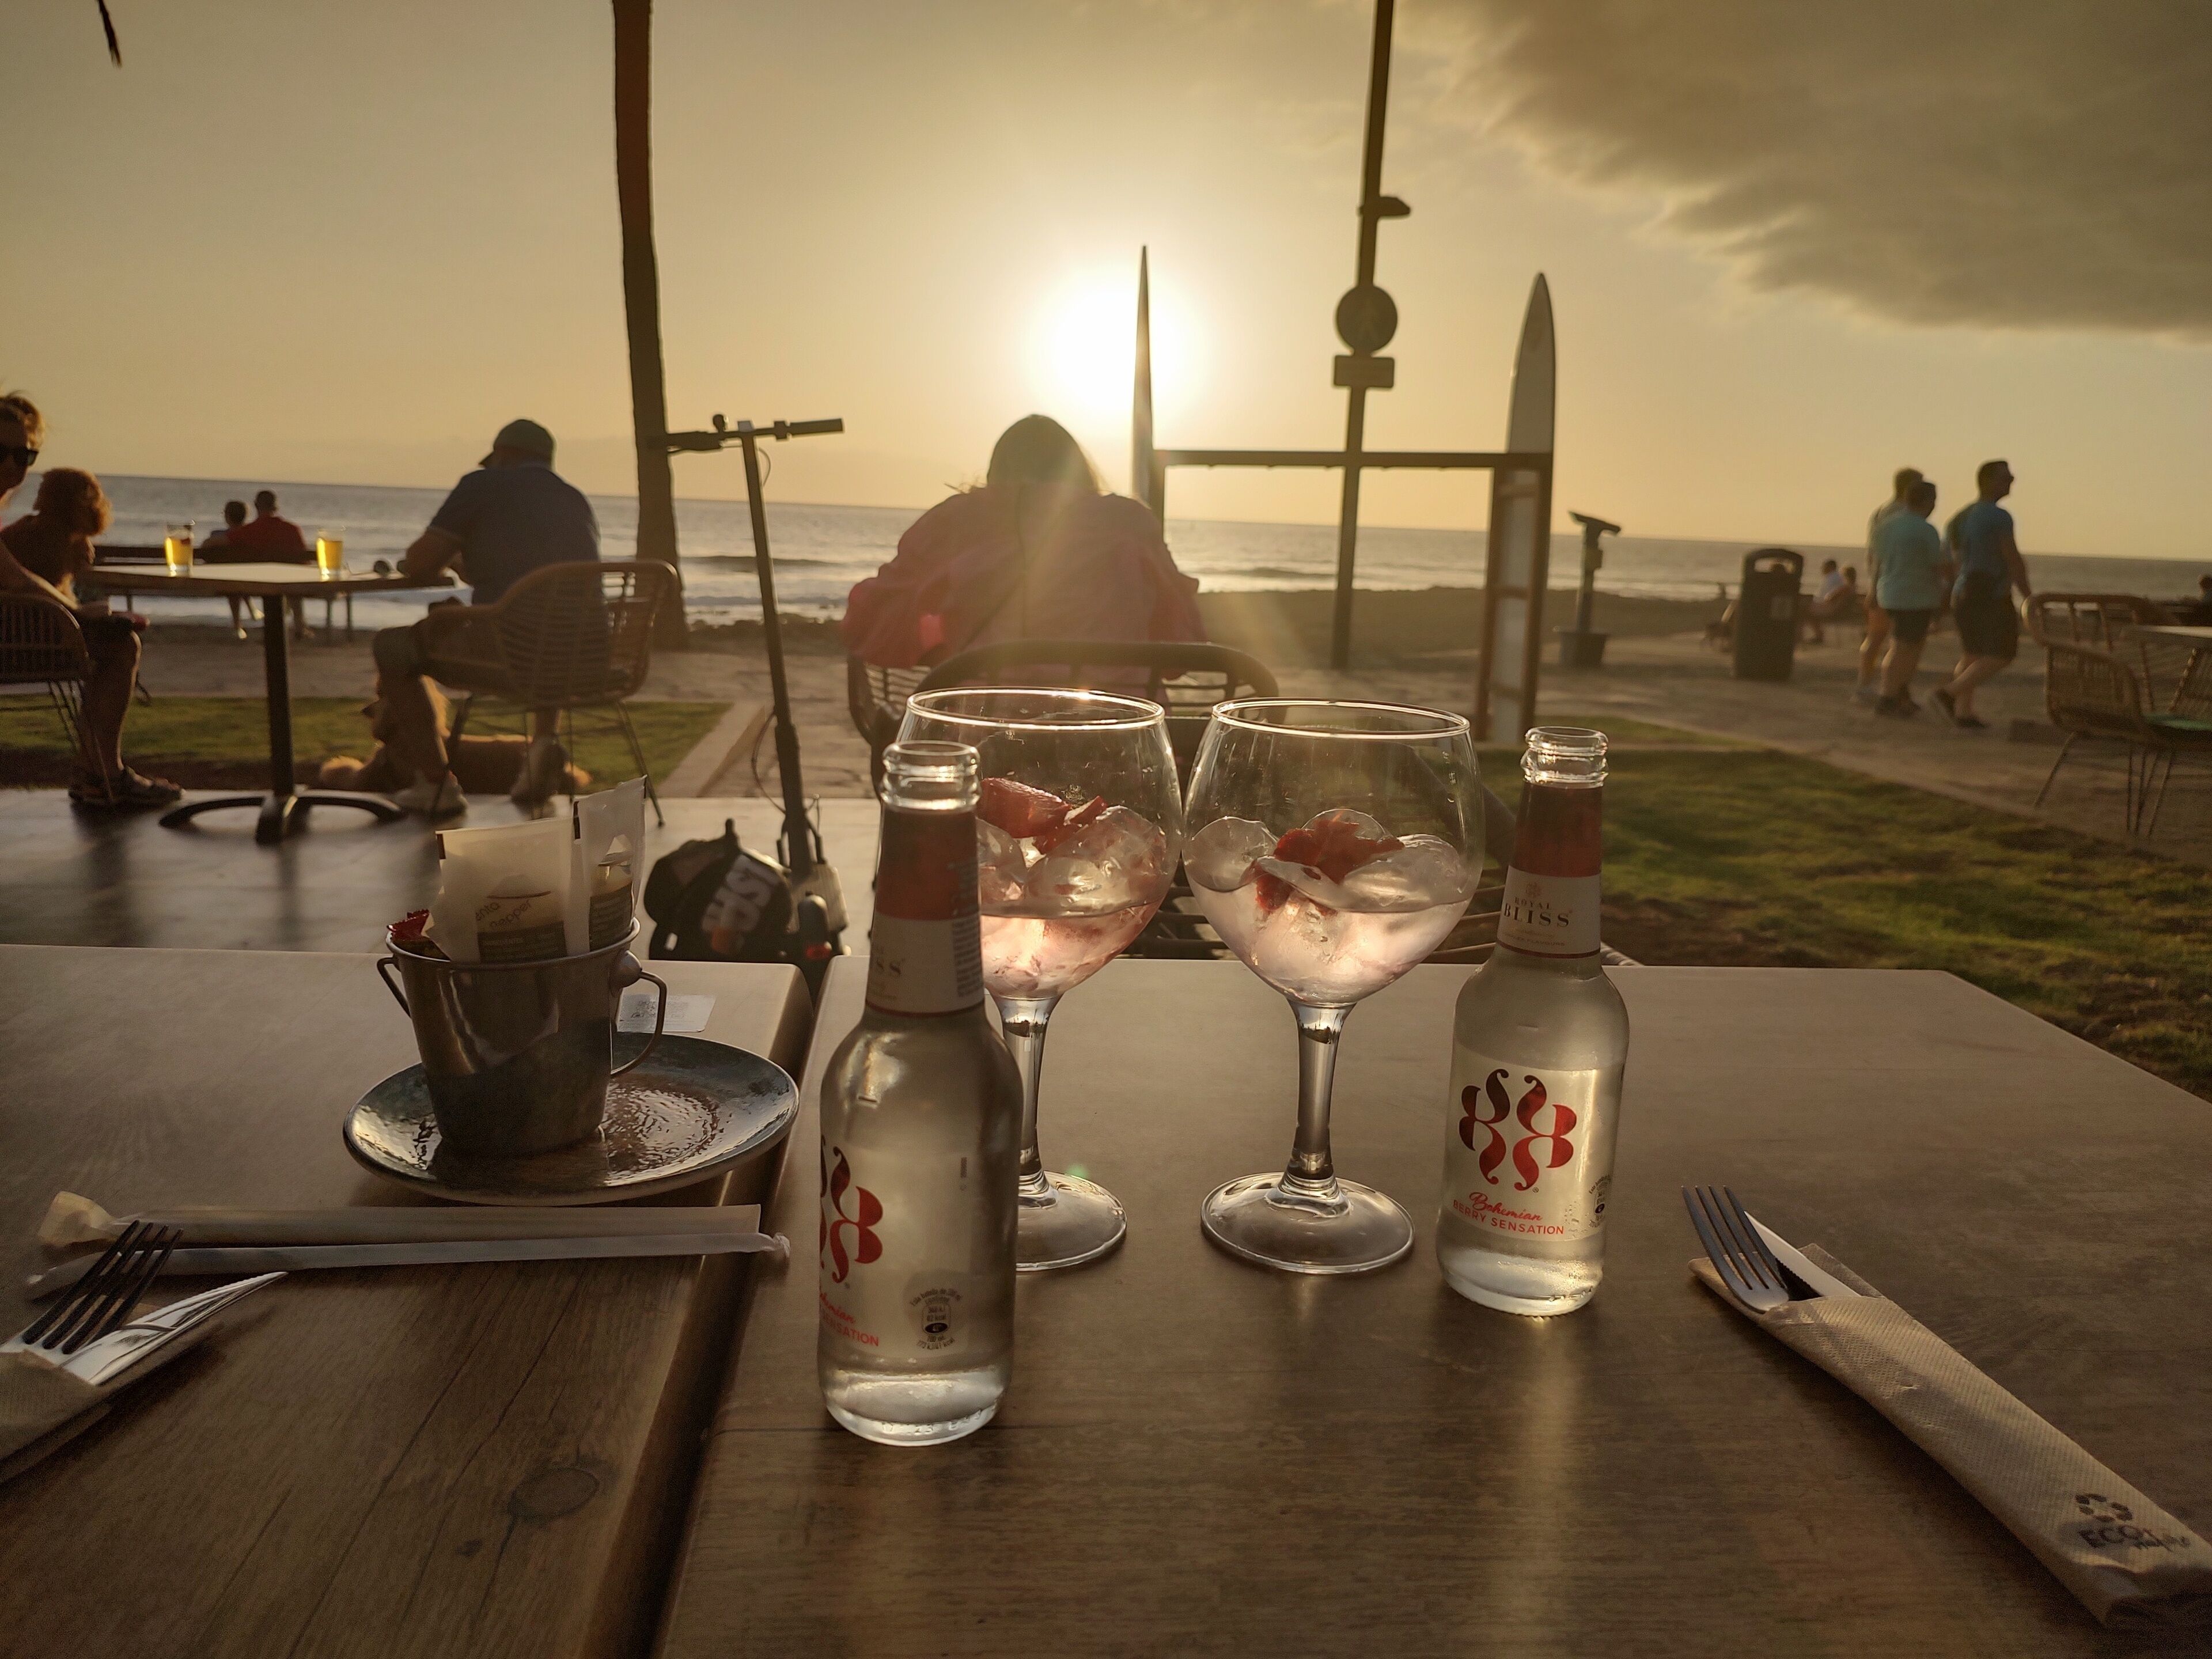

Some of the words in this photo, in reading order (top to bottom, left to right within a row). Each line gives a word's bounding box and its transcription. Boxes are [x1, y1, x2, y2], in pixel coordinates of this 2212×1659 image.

[1504, 903, 1570, 928] BLISS
[1514, 896, 1551, 910] ROYAL
[1453, 1199, 1487, 1223] BERRY
[1490, 1217, 1565, 1236] SENSATION
[1469, 1192, 1543, 1221] Bohemian
